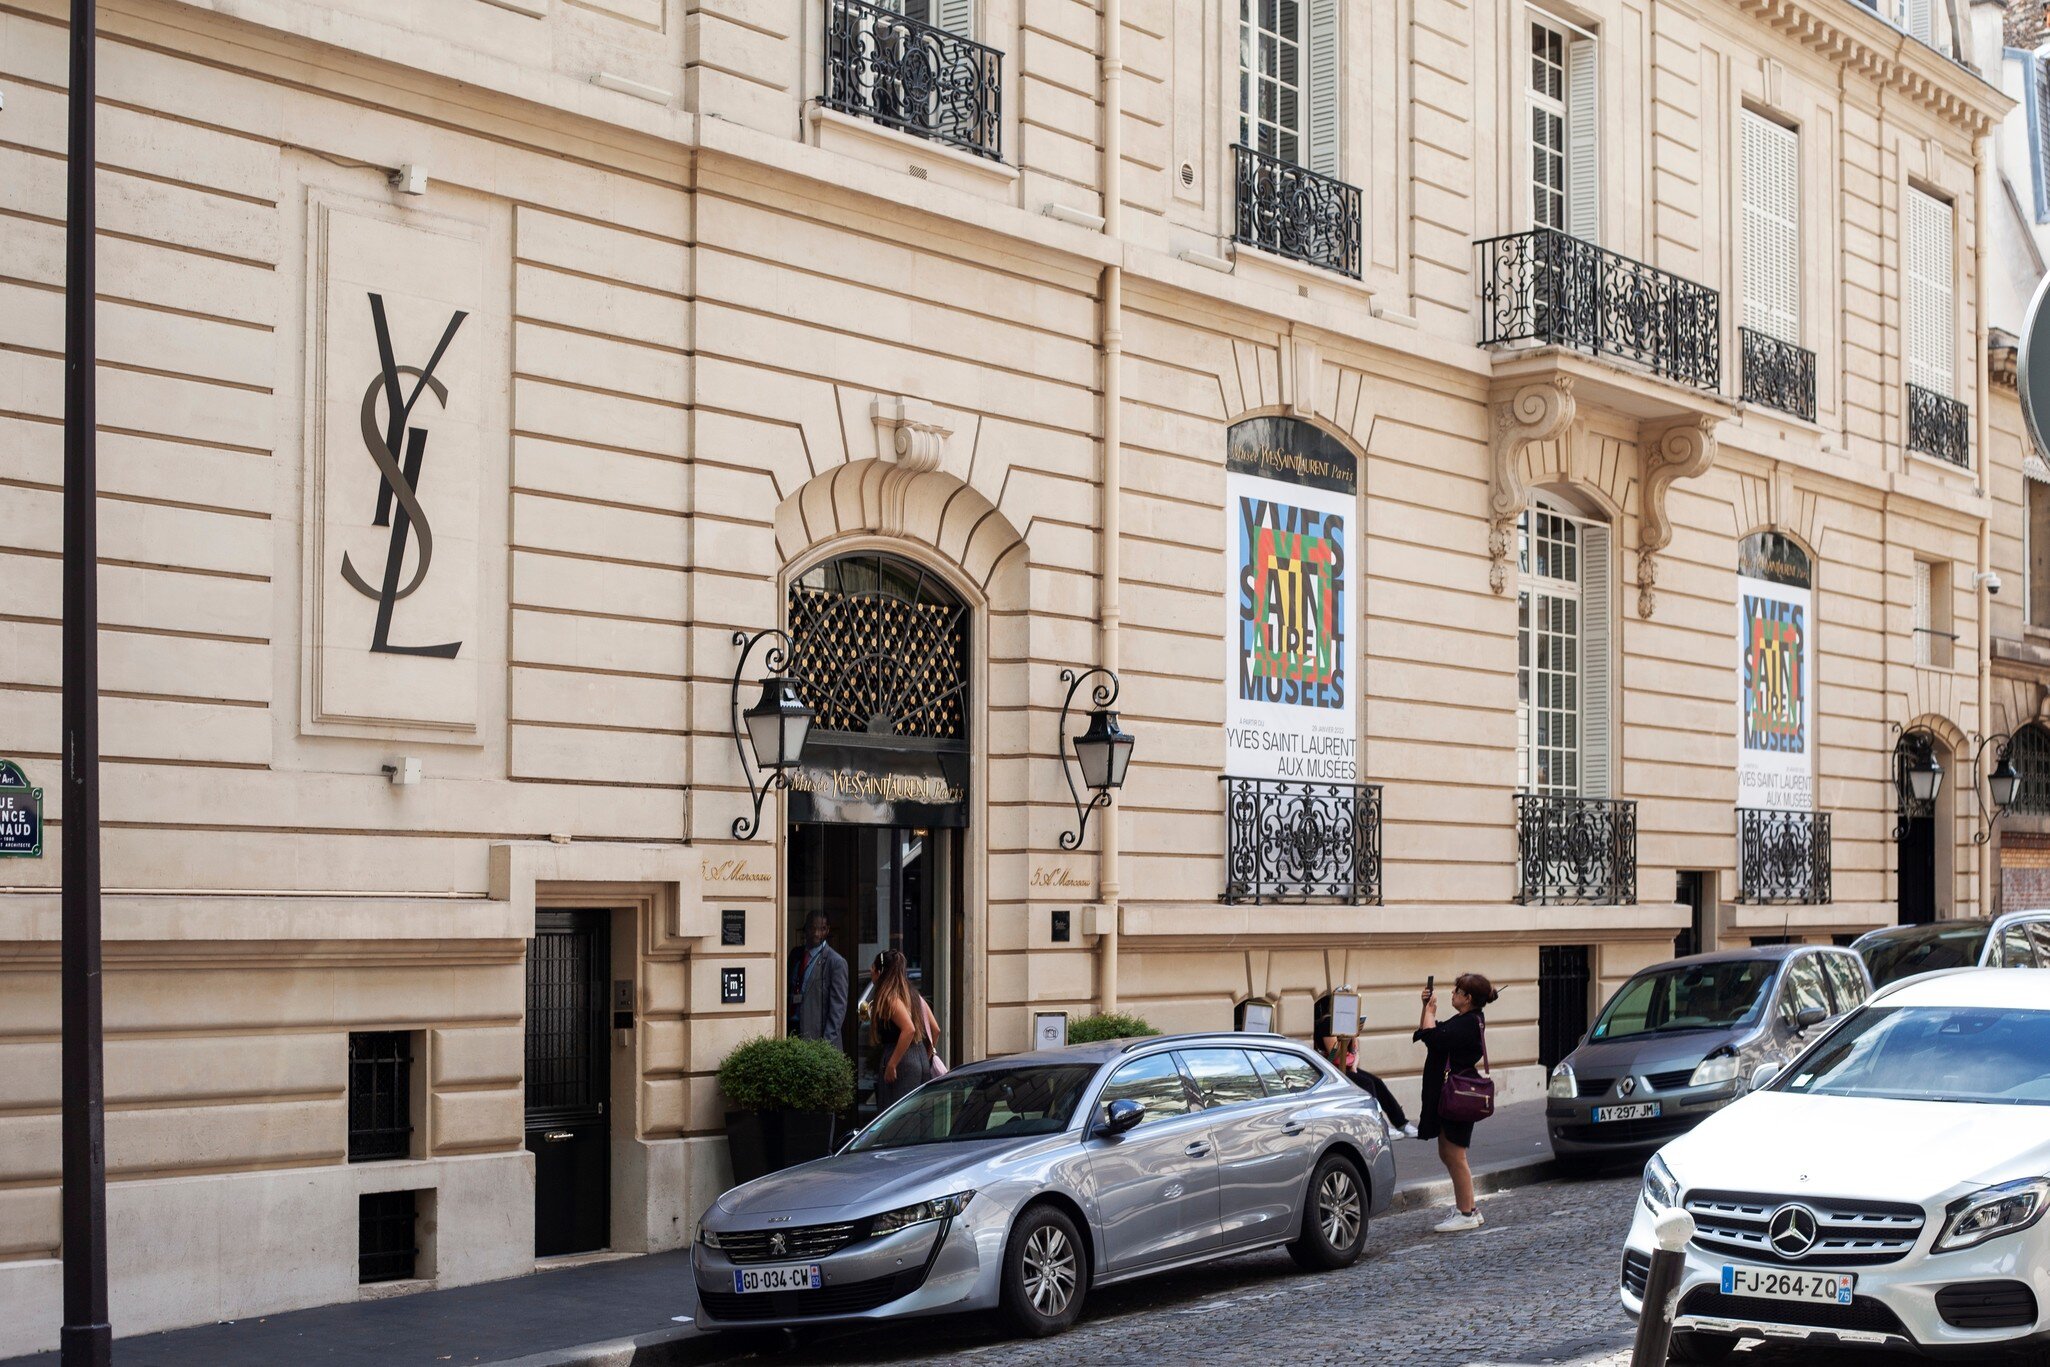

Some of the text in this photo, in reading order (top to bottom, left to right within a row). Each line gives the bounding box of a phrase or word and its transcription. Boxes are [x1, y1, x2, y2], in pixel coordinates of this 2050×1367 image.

[340, 292, 470, 659] YSL
[1331, 464, 1354, 482] Paris
[1227, 728, 1356, 757] YVES SAINT LAURENT
[1278, 756, 1356, 780] AUX MUSÉES
[933, 781, 965, 799] Paris
[1757, 772, 1778, 788] SAINT
[1780, 774, 1812, 791] LAURENT
[0, 797, 14, 809] UE
[1766, 790, 1782, 806] AUX
[1, 811, 26, 823] NCE
[0, 824, 31, 836] NAUD
[743, 1268, 809, 1289] GD-034-CW
[1733, 1270, 1838, 1300] FJ-264-ZQ
[1839, 1291, 1850, 1301] 75
